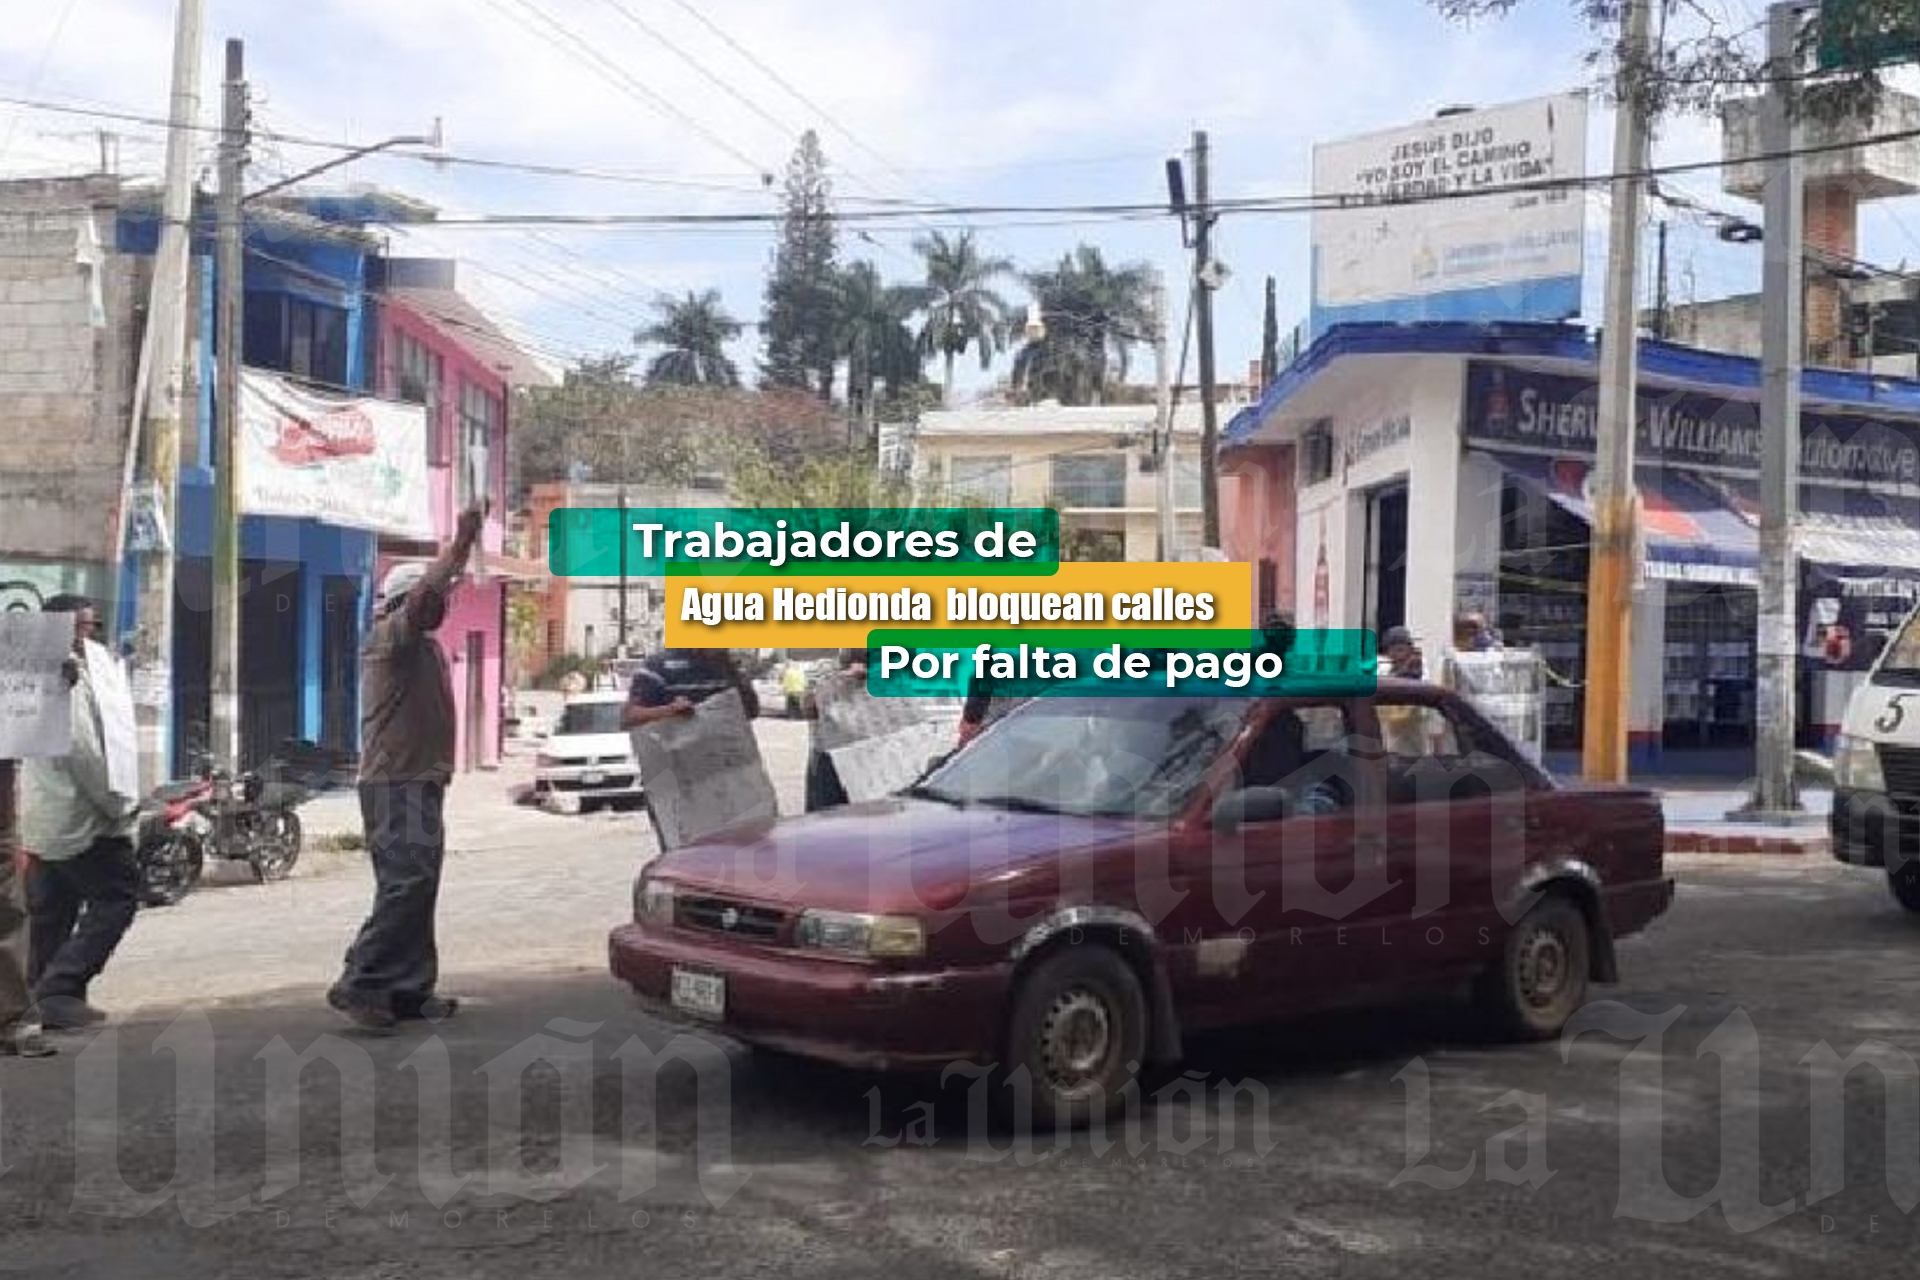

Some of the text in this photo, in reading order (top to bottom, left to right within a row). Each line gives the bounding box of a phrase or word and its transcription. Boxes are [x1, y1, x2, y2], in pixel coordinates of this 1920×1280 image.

[1452, 127, 1493, 150] DIJO
[1390, 160, 1426, 182] SOY
[1433, 157, 1453, 175] EL
[1456, 140, 1531, 168] CAMINO
[1472, 167, 1493, 185] LA
[1799, 435, 1915, 478] utomotive
